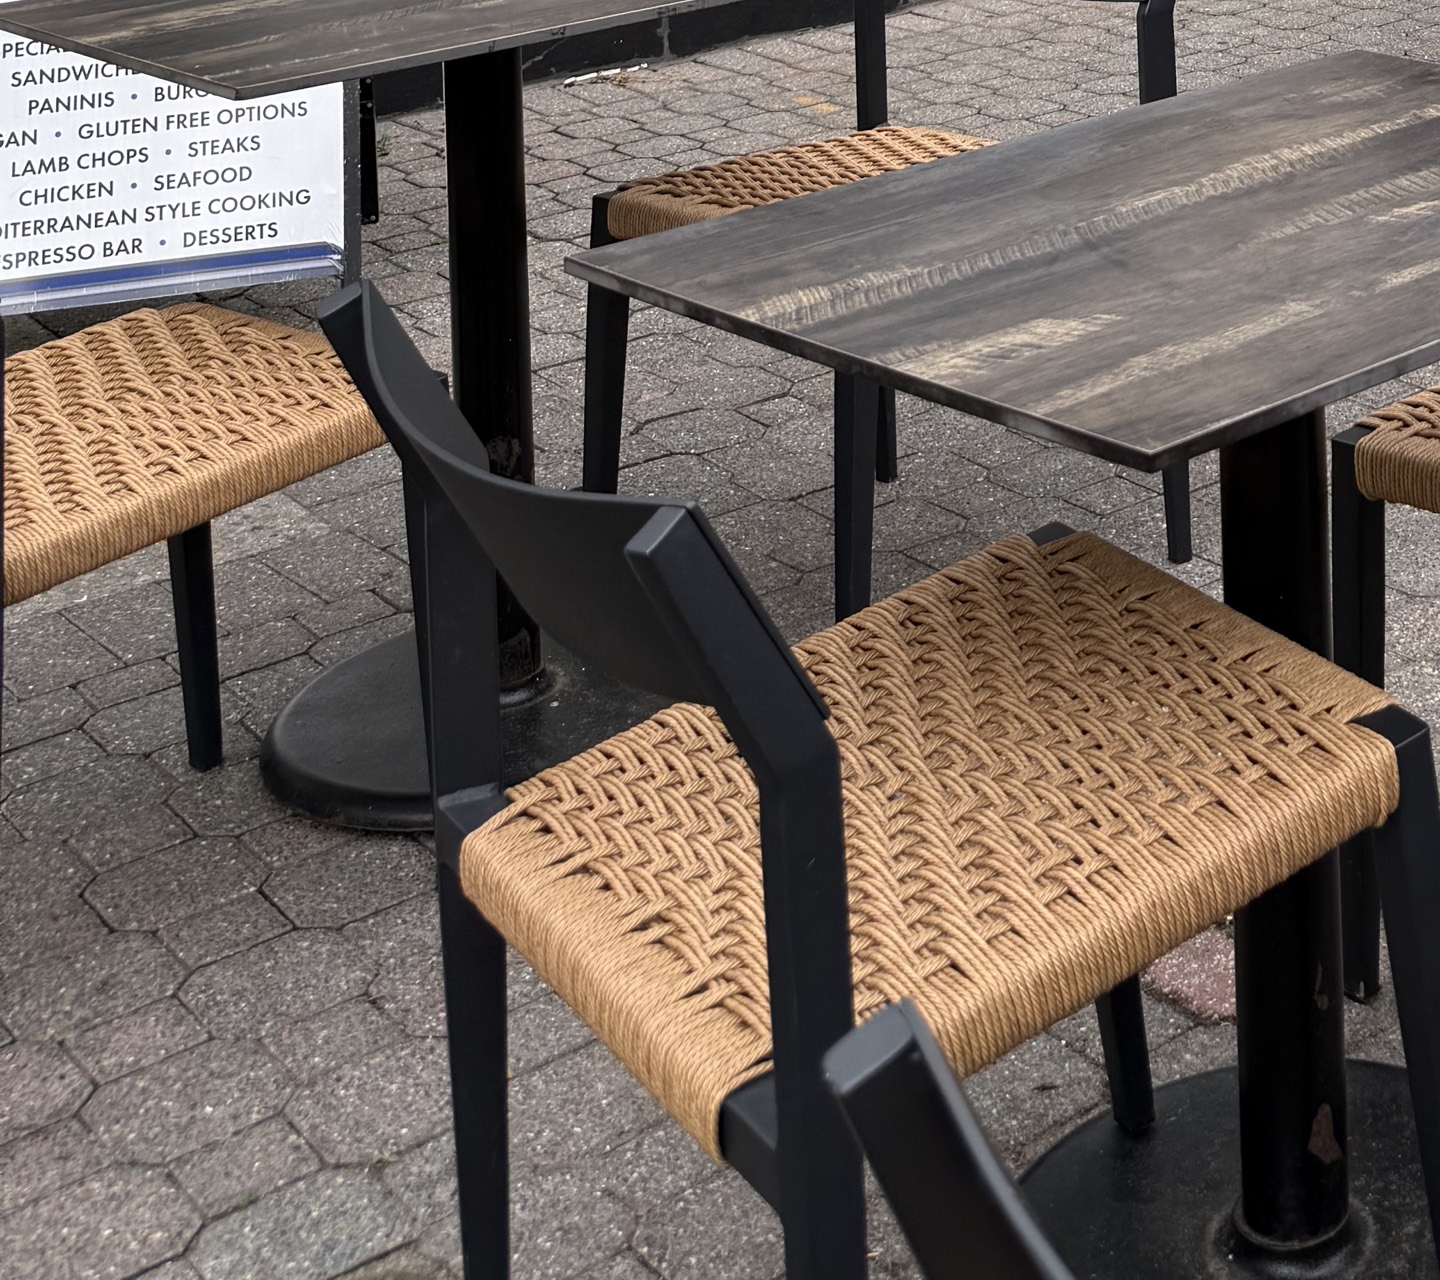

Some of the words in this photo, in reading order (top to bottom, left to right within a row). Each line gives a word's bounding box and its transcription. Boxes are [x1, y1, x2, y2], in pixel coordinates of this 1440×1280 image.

[28, 91, 115, 116] PANINIS
[78, 116, 158, 140] GLUTEN
[166, 111, 211, 131] FREE
[217, 101, 308, 125] OPTIONS
[11, 156, 70, 178] LAMB
[77, 147, 149, 170] CHOPS
[188, 135, 261, 158] STEAKS
[19, 180, 114, 207] CHICKEN
[153, 166, 253, 192] SEAFOOD
[144, 200, 202, 223] STYLE
[208, 189, 312, 215] COOKING
[103, 238, 143, 258] BAR
[183, 222, 279, 248] DESSERTS
